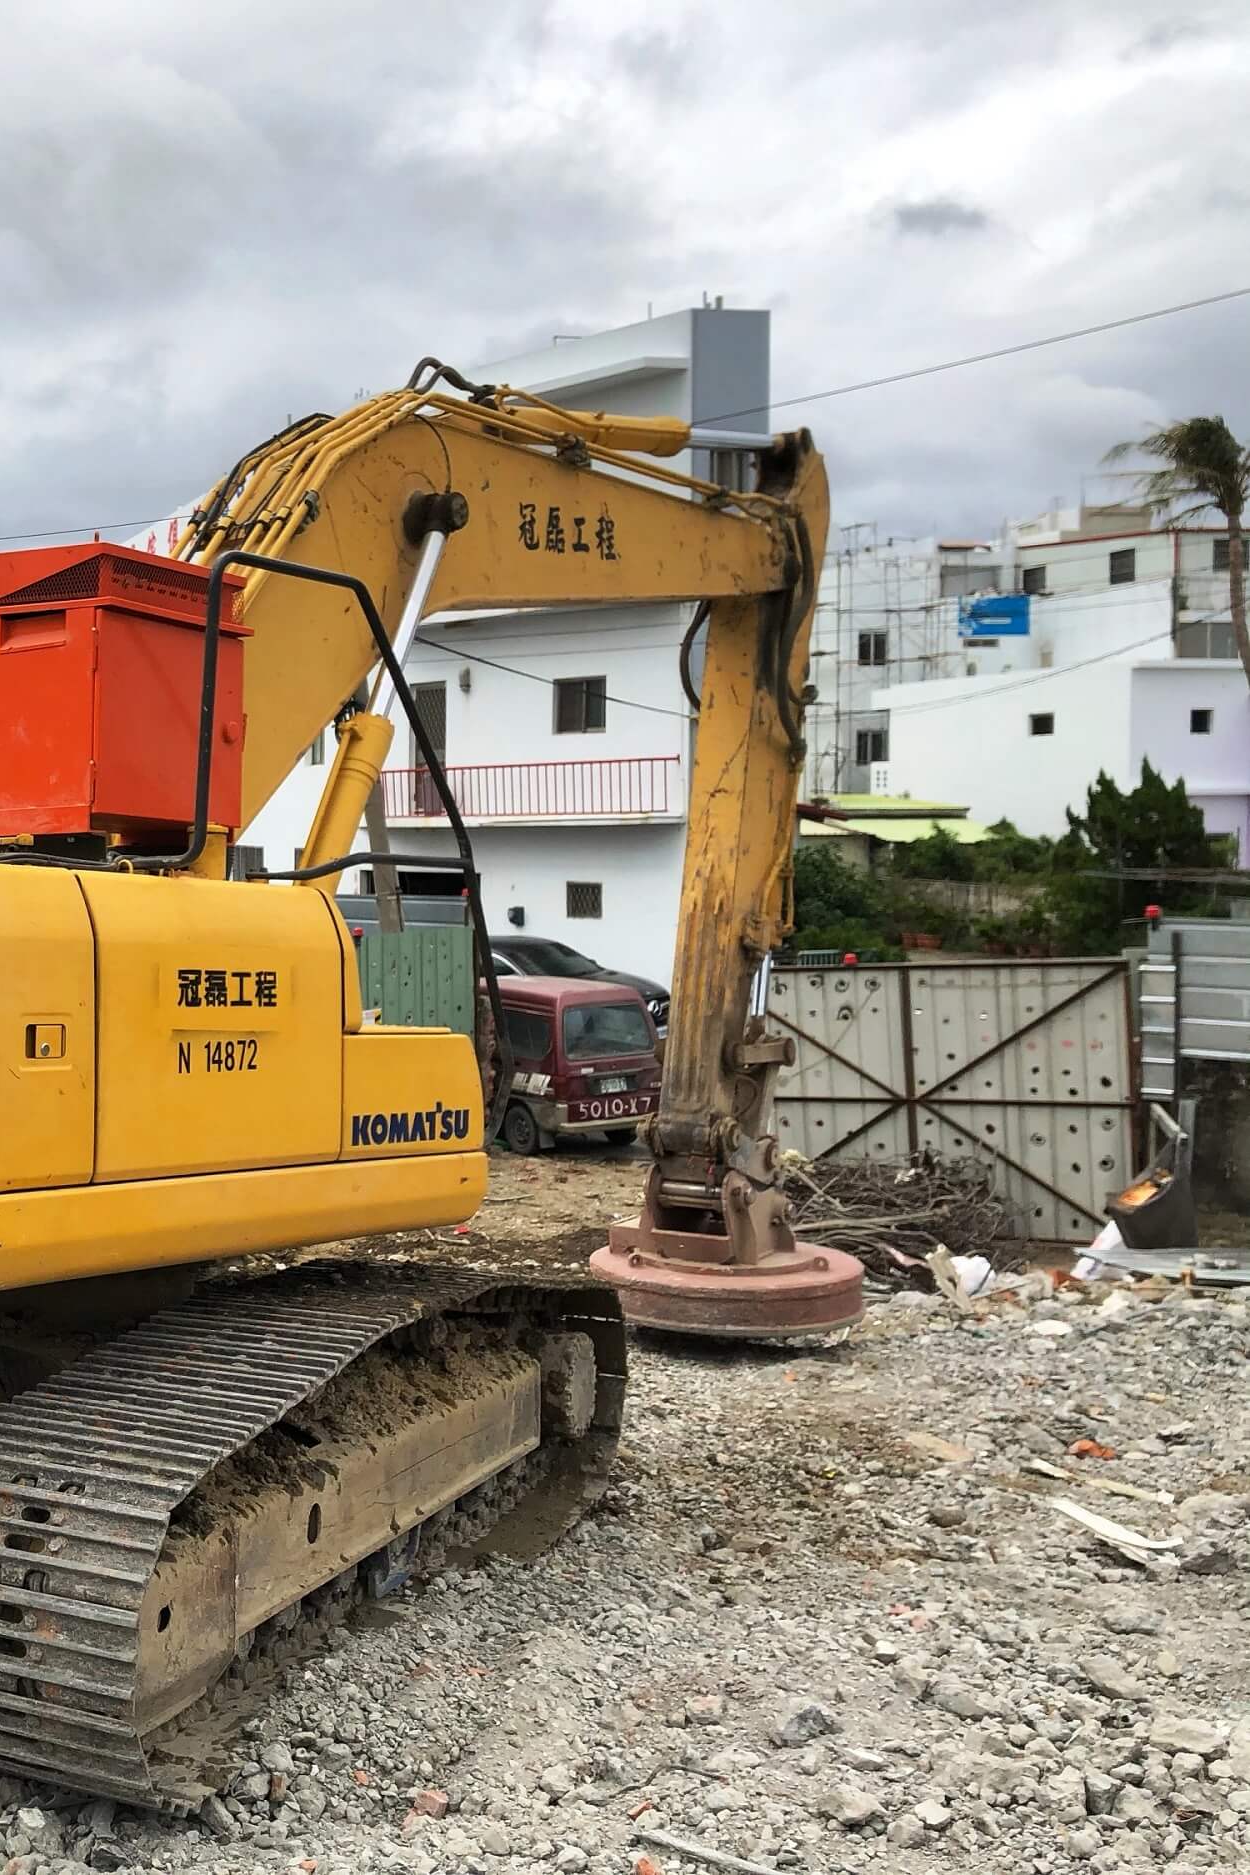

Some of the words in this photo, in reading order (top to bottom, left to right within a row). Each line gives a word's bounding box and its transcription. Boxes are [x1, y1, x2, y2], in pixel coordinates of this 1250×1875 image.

[518, 502, 616, 561] 冠磊工程
[178, 969, 277, 1008] 冠磊工程
[178, 1042, 190, 1074] N
[205, 1039, 258, 1072] 14872
[351, 1101, 470, 1146] KOMATSU
